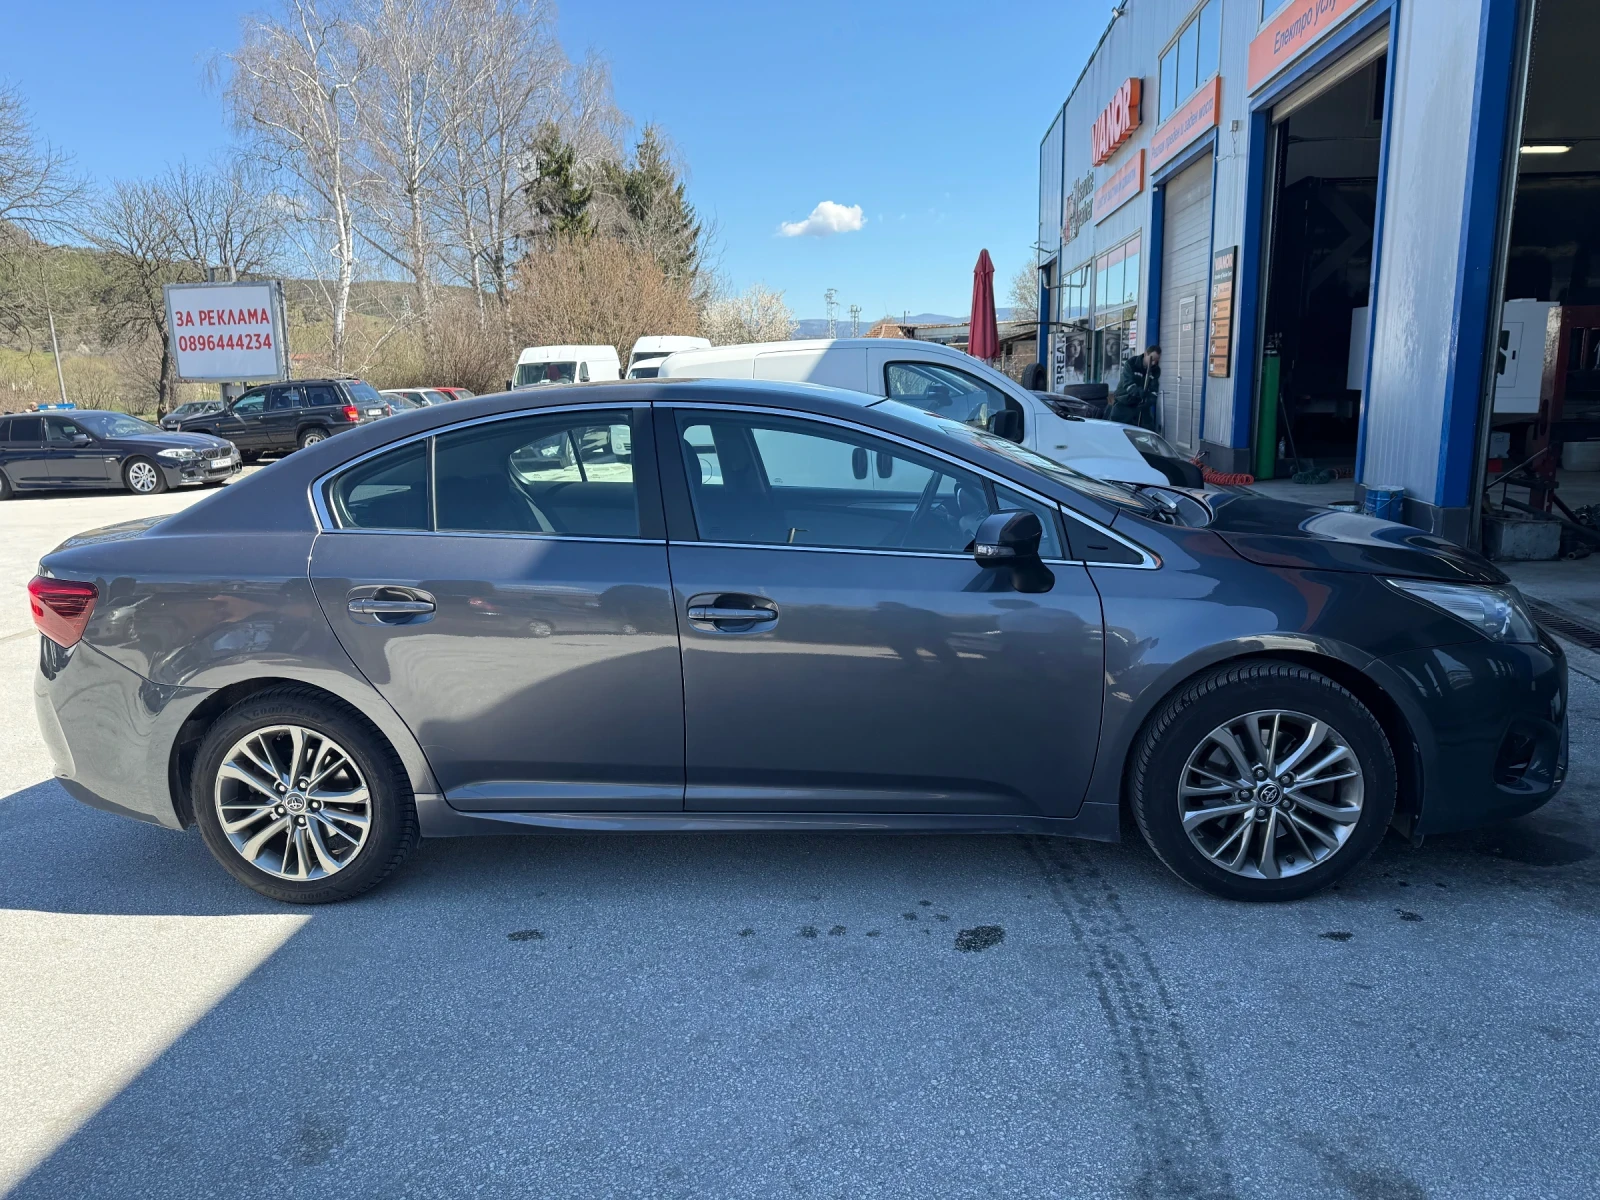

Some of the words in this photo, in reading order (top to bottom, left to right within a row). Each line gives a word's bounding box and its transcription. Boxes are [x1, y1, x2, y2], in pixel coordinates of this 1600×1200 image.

[1091, 77, 1138, 167] VIANOR
[175, 311, 195, 327] ЗА
[199, 308, 270, 326] РЕКЛАМА
[178, 333, 272, 352] 0896444234
[1056, 330, 1065, 384] BREAK
